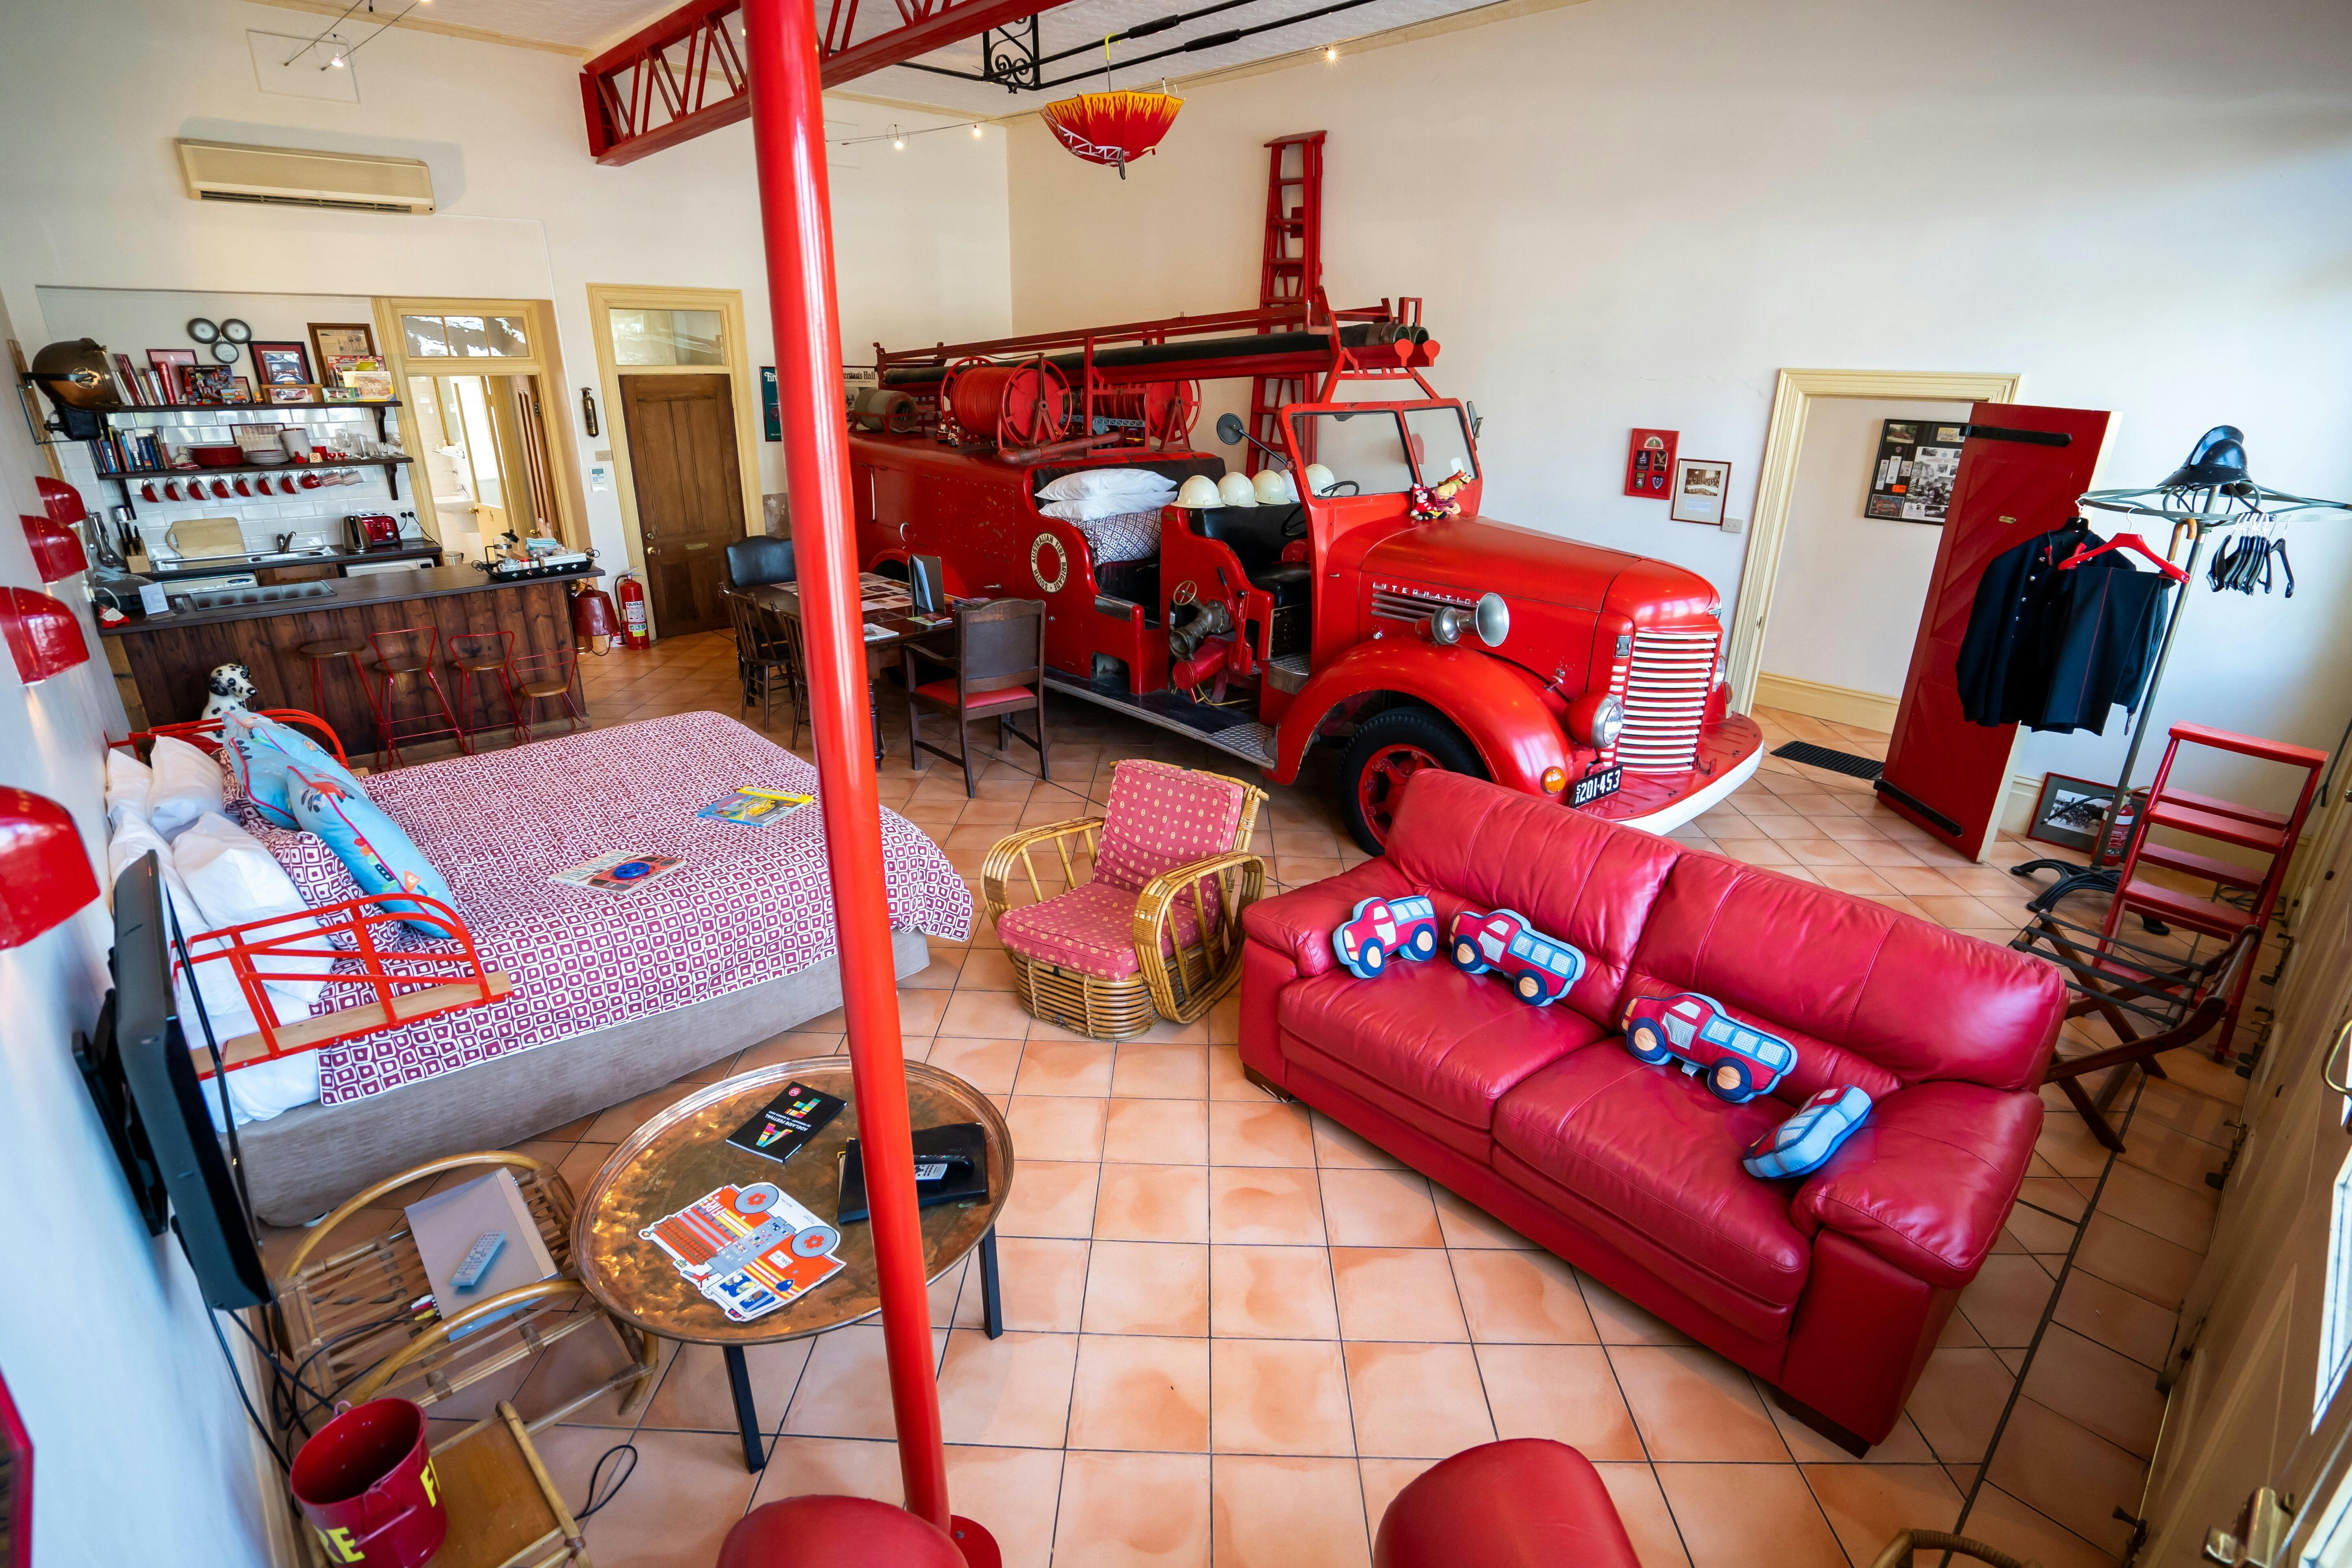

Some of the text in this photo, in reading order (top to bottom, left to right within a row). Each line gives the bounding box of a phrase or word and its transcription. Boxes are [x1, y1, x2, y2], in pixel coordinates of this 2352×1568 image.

[864, 371, 875, 380] Hall
[1032, 534, 1066, 591] SOUTH AUSTRALIAN FIRE BRIGADE
[1373, 581, 1480, 606] INTERNATIO
[562, 869, 592, 881] FIRE
[589, 852, 631, 870] ENGINE
[764, 1113, 809, 1132] ADELAIDE FESTIVAL
[701, 1199, 727, 1217] FIRE
